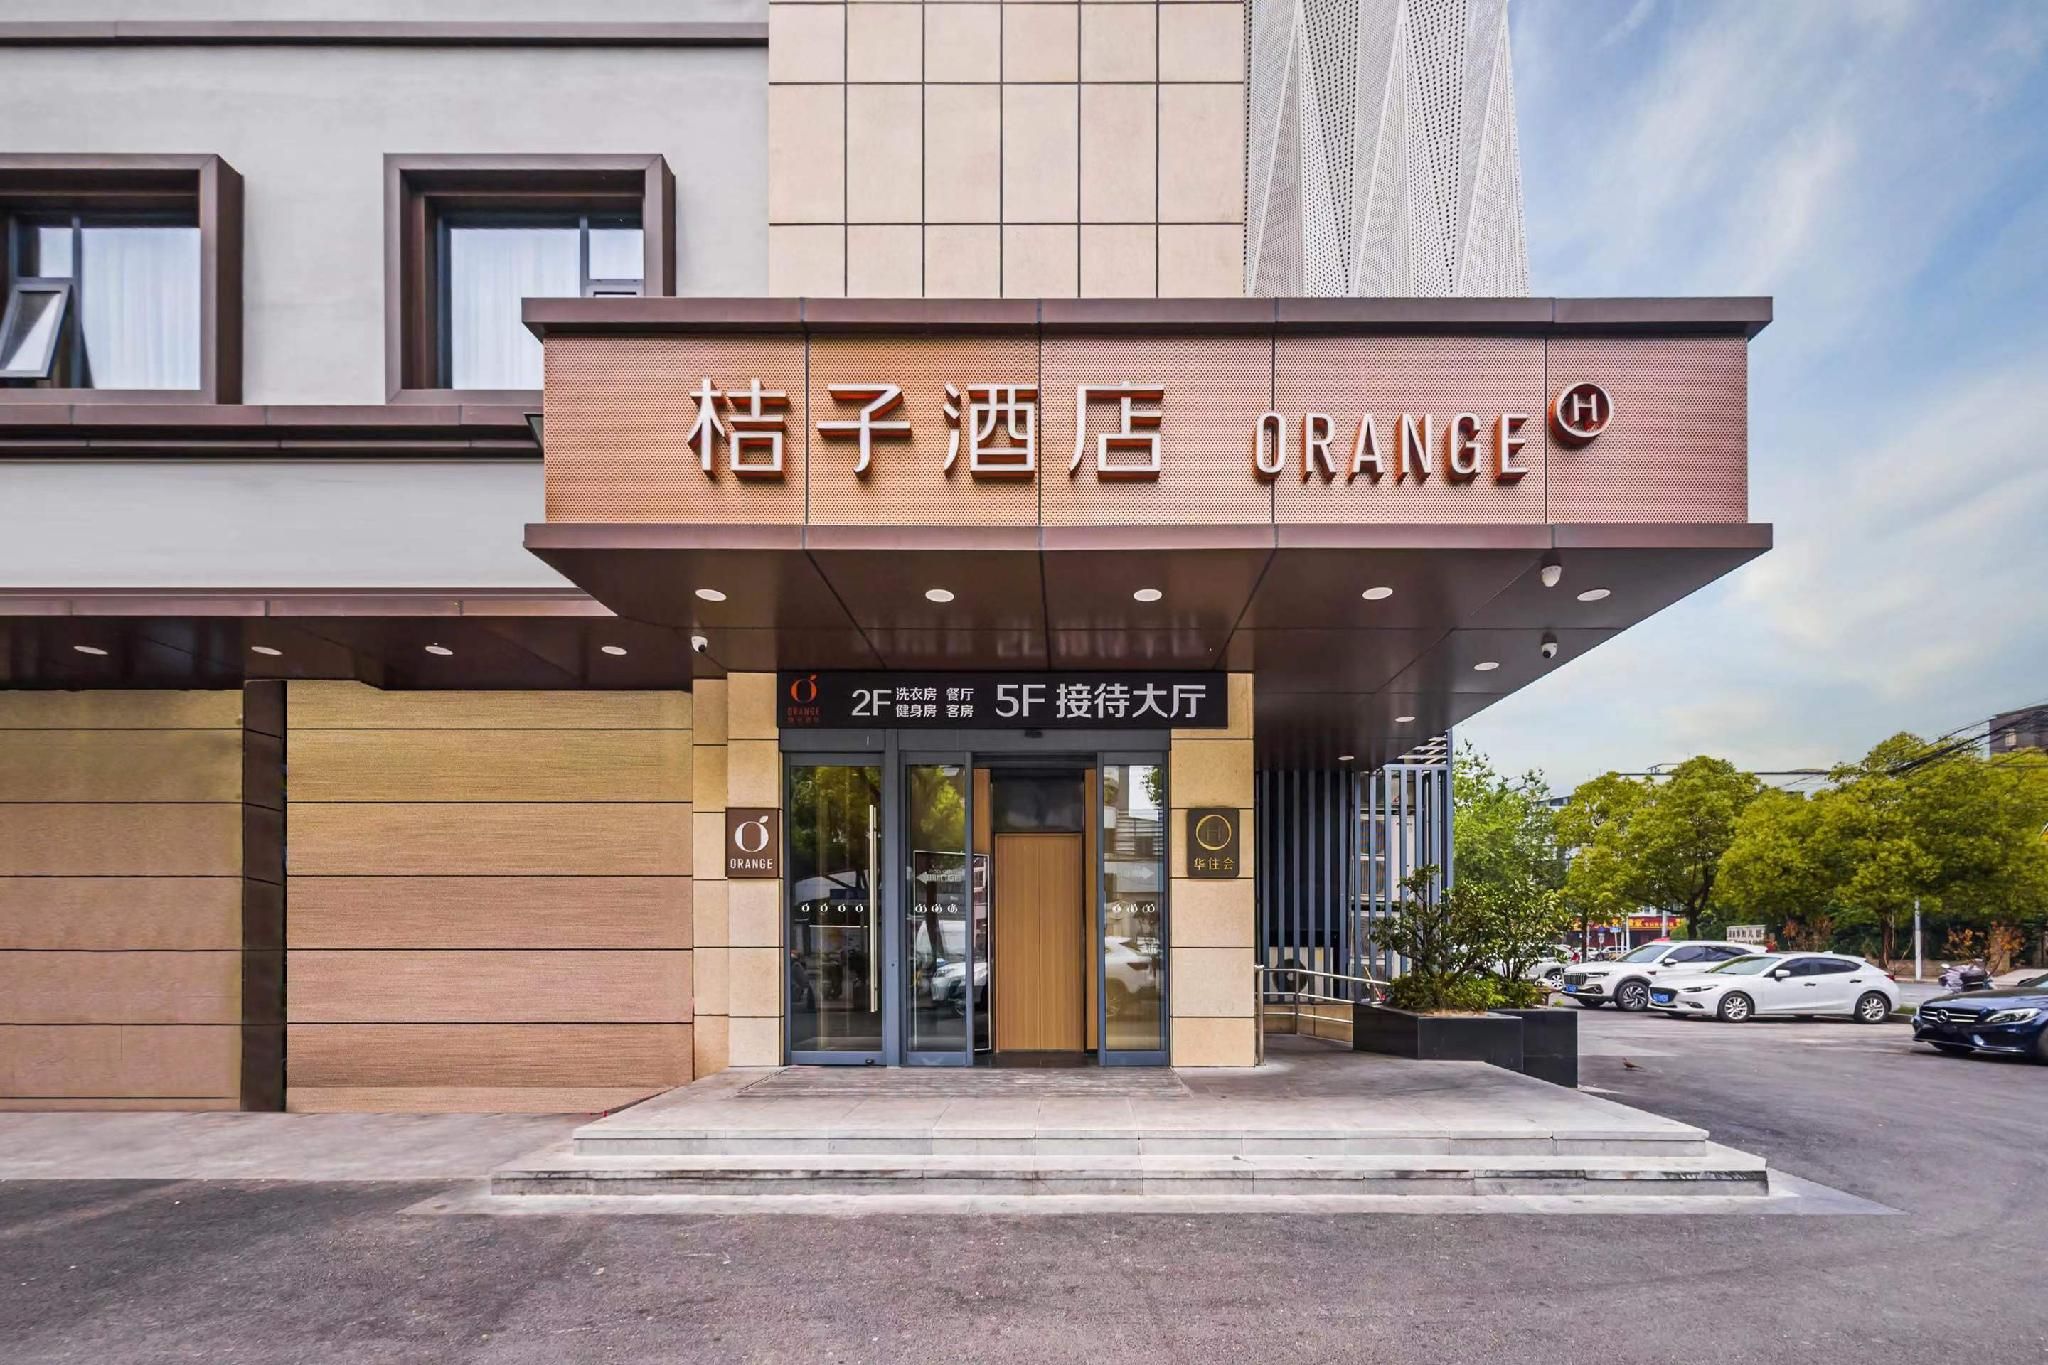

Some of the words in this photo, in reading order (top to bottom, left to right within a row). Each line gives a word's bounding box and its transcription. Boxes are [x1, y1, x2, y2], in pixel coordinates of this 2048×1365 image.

[688, 377, 1164, 478] 桔子酒店
[1254, 411, 1529, 479] ORANGE
[851, 689, 892, 716] 2F
[895, 687, 938, 701] 洗衣房
[946, 687, 974, 701] 餐厅
[895, 704, 938, 718] 健身房
[946, 704, 974, 718] 客房
[995, 684, 1046, 718] 5F
[1056, 682, 1206, 718] 接待大厅
[730, 858, 773, 870] ORANGE
[1194, 856, 1235, 871] 华住会
